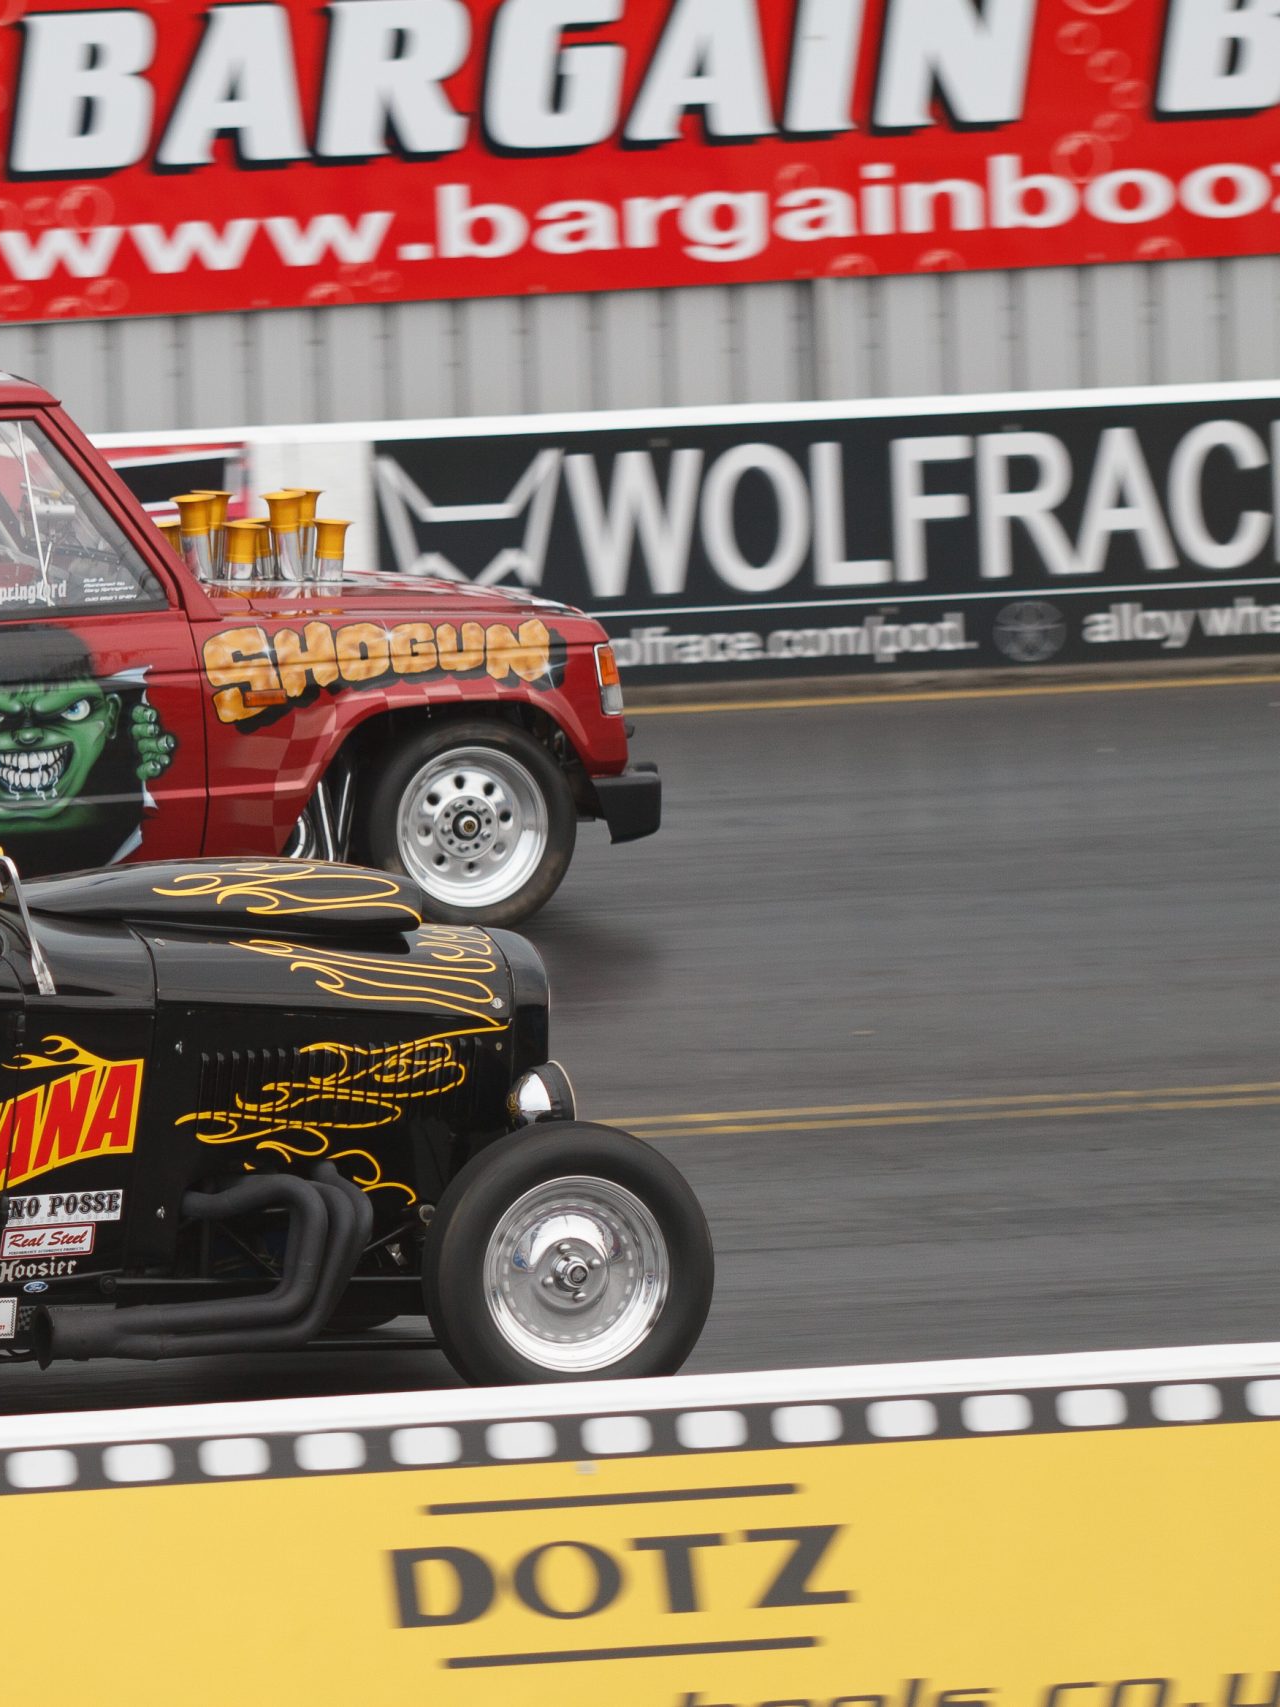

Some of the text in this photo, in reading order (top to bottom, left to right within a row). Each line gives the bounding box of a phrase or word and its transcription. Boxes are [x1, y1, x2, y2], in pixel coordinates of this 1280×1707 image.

[8, 0, 1036, 174] BARGAIN
[563, 419, 1280, 597] WOLFRAC
[202, 617, 552, 723] SHOGUN
[7, 1229, 89, 1249] Real Steel
[8, 1196, 41, 1220] NO
[46, 1191, 120, 1217] POSSE
[388, 1522, 856, 1630] DOTZ
